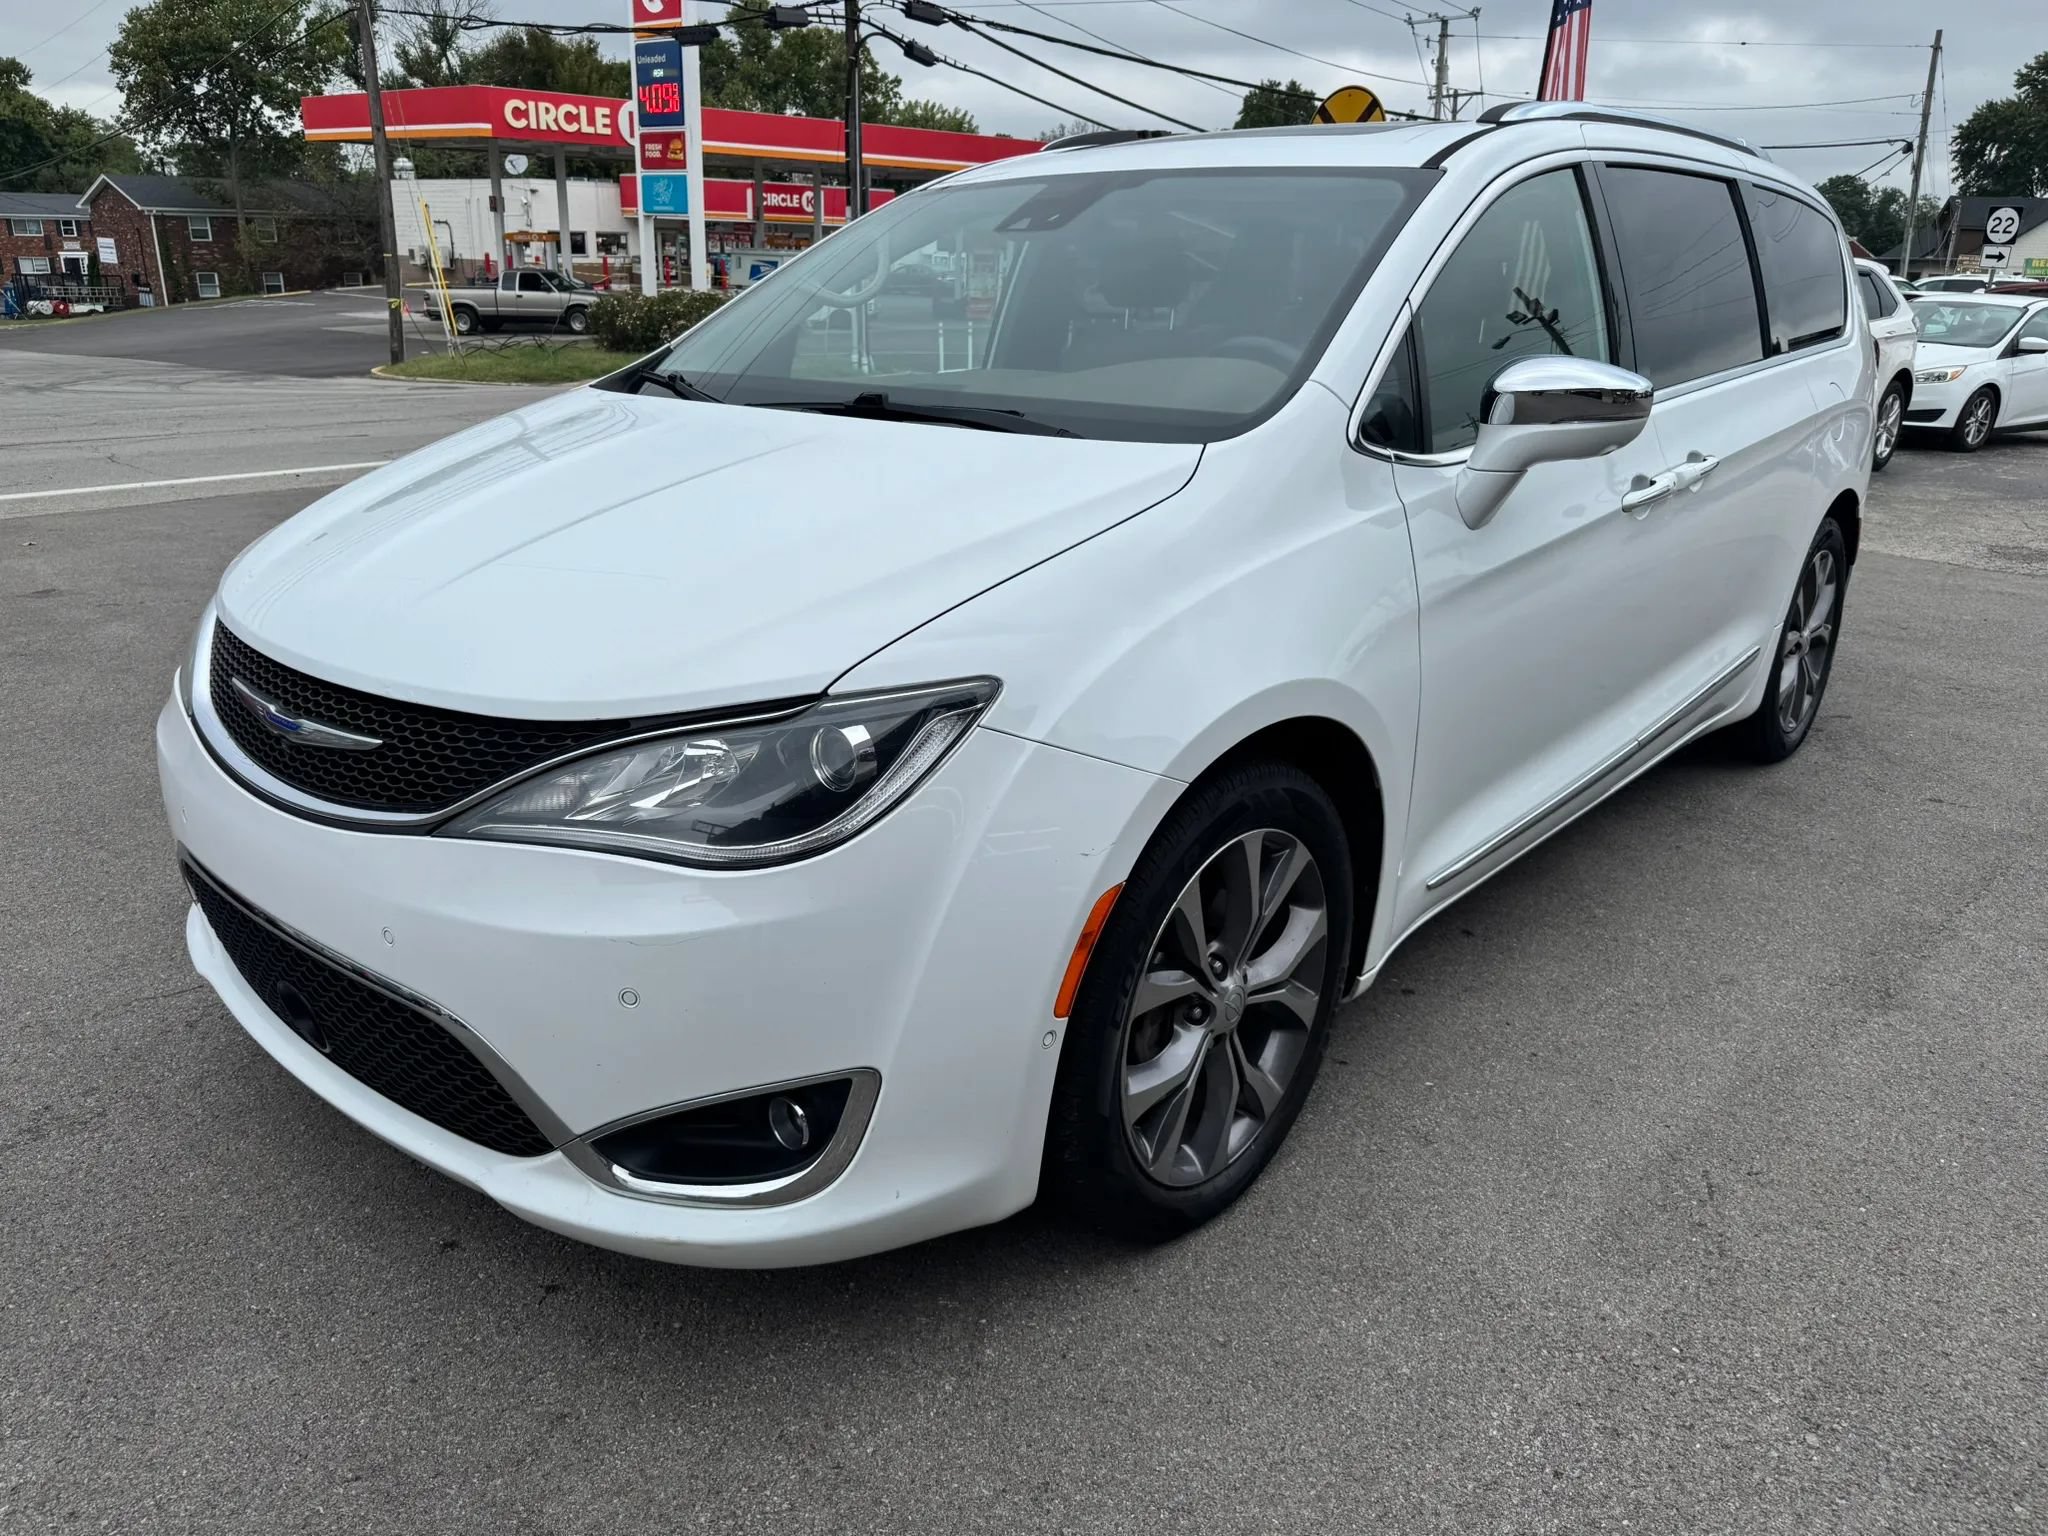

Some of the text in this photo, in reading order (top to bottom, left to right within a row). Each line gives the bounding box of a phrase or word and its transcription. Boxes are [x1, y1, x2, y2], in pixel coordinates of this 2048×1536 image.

[637, 53, 666, 64] Unleaded
[504, 99, 612, 135] CIRCLE
[1989, 216, 2015, 234] 22
